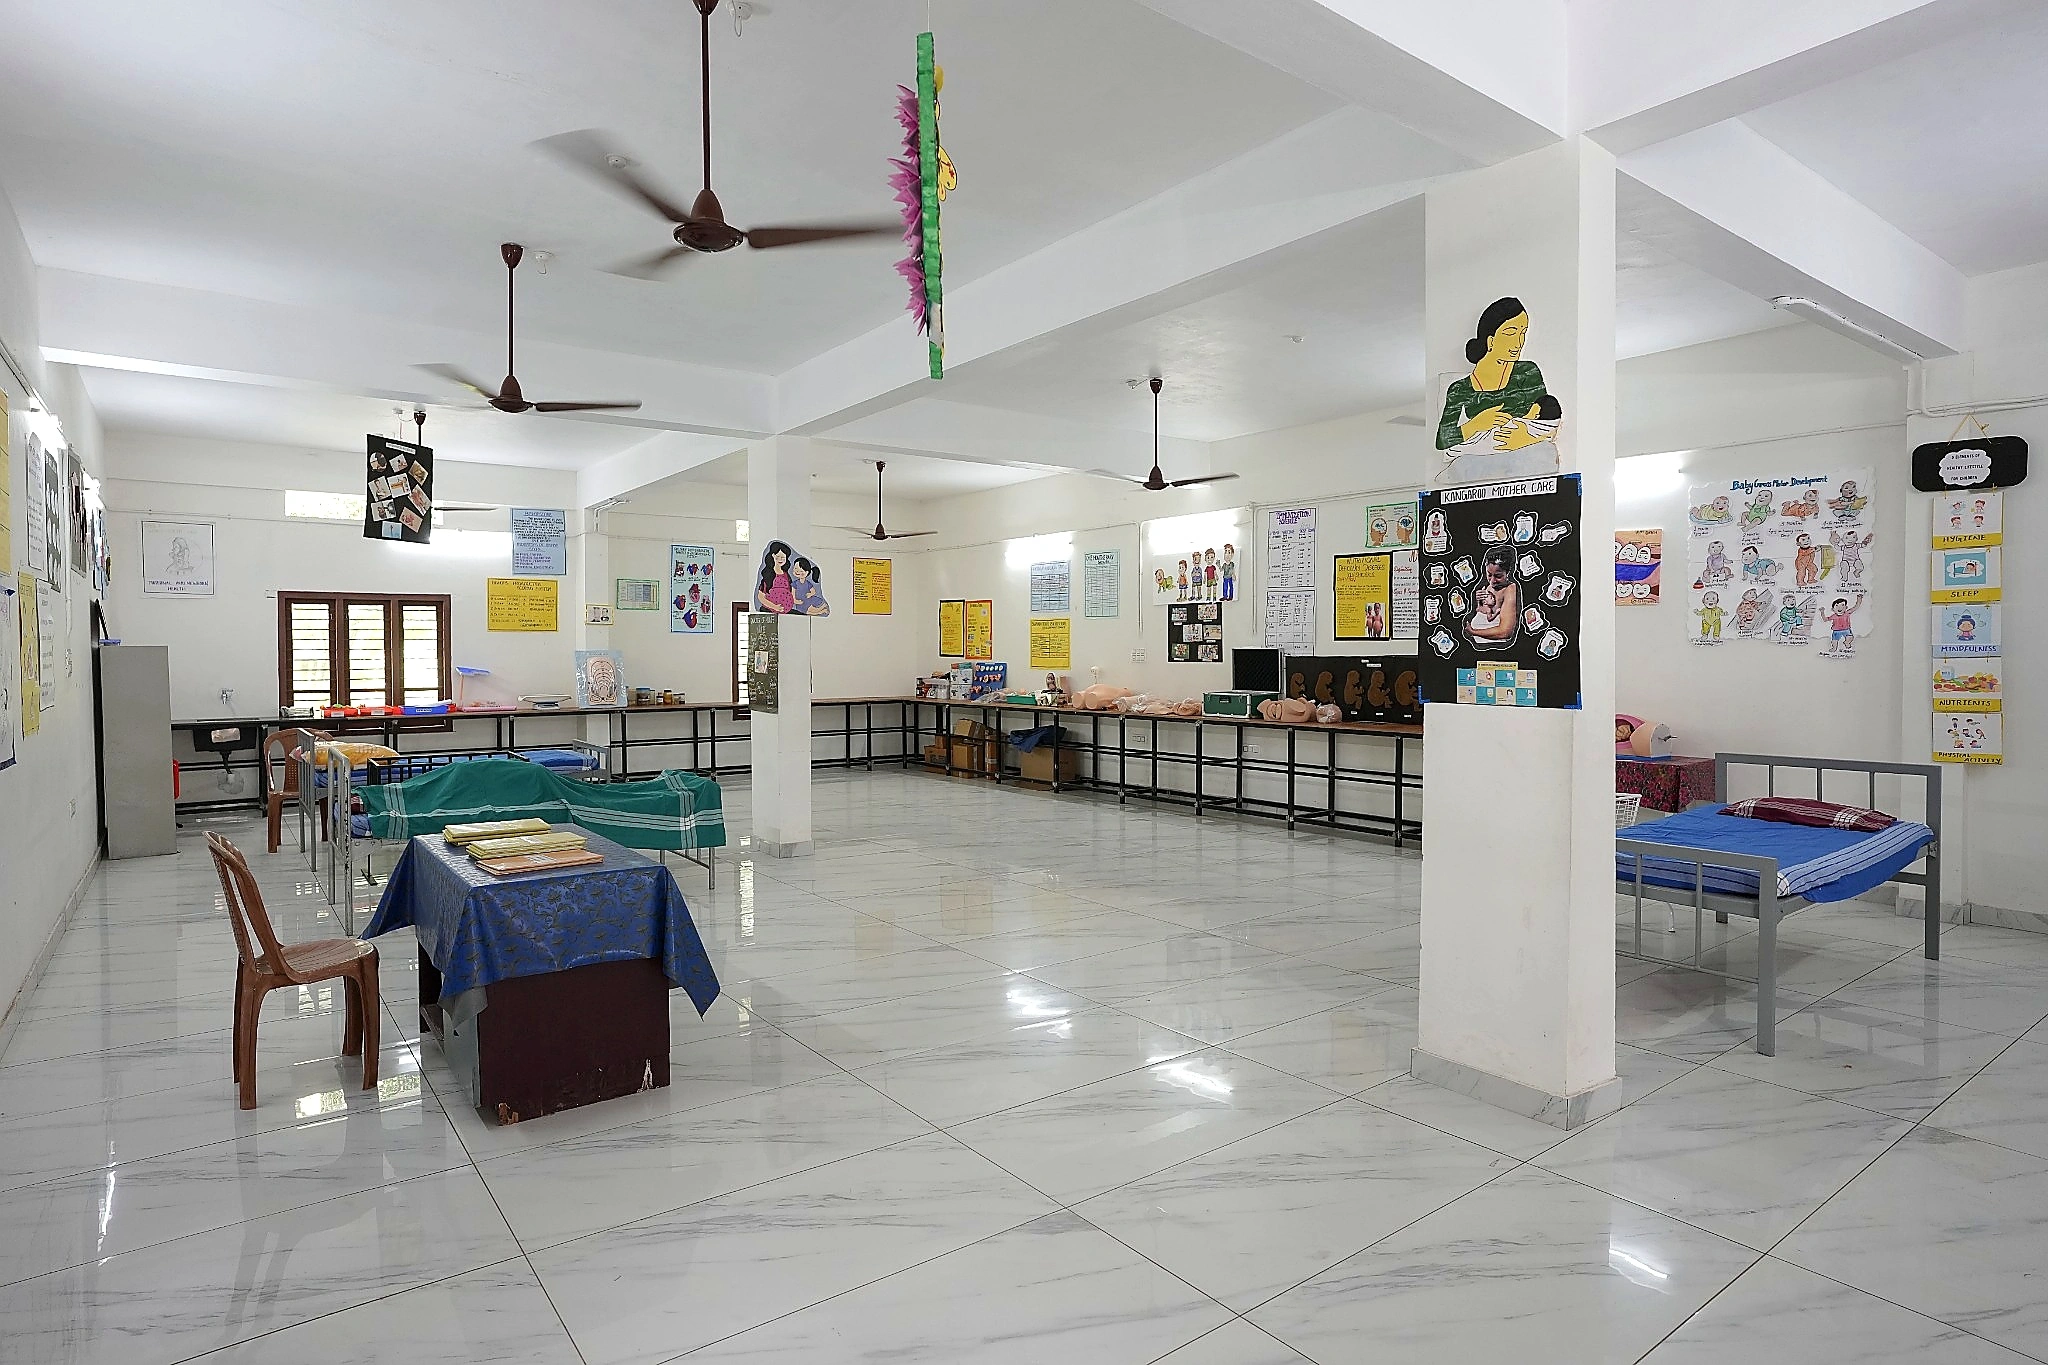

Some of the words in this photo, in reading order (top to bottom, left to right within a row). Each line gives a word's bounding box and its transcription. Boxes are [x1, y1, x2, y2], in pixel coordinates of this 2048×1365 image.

[1730, 479, 1754, 494] Baby
[1444, 488, 1486, 502] KANGAROO
[1491, 484, 1527, 497] MOTHER
[1531, 480, 1555, 493] CARE
[1943, 534, 1986, 543] HYGIENE
[1950, 590, 1979, 598] SLEEP
[1940, 645, 1997, 653] MINDFULNESS
[1939, 699, 1991, 707] NUTRIENTS
